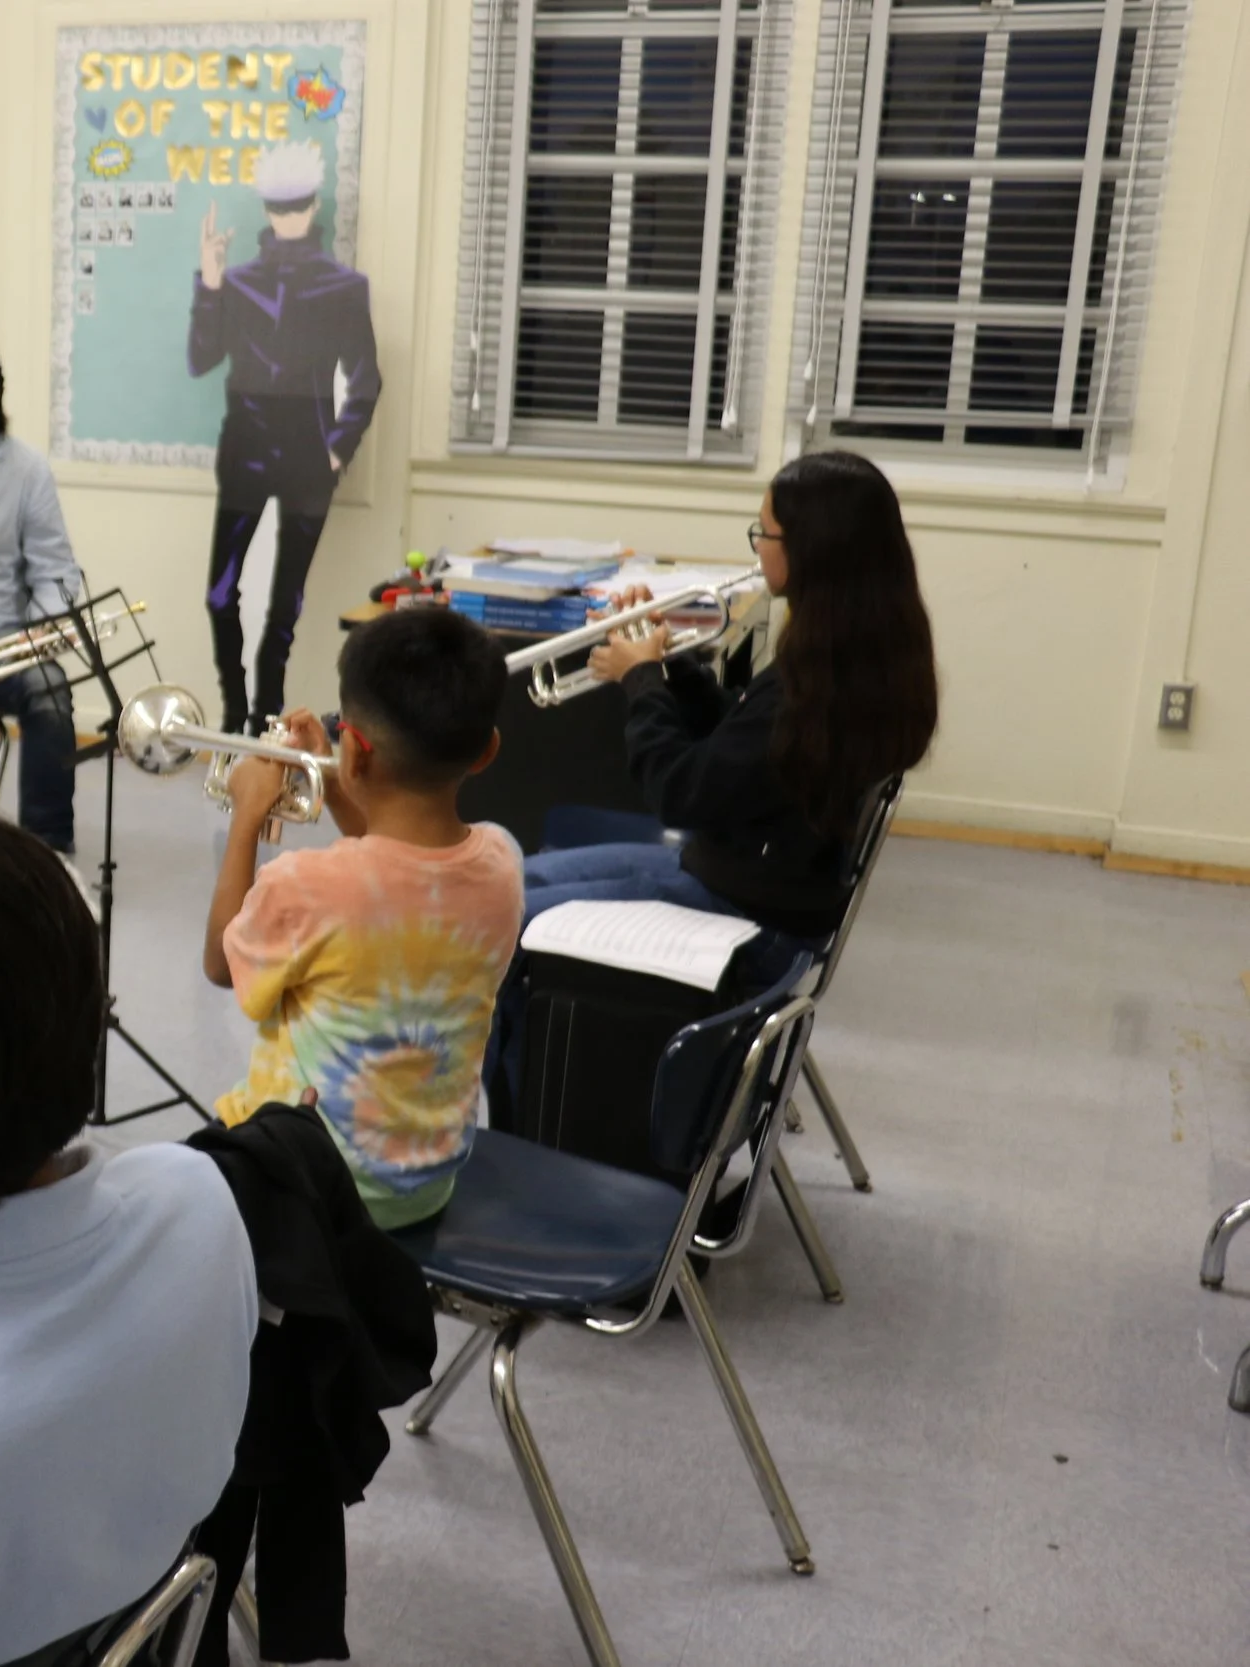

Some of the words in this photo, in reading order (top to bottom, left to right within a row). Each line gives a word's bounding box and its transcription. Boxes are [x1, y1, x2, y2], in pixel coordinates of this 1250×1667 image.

[80, 52, 293, 91] STUDENT
[114, 98, 175, 138] OF
[202, 101, 290, 140] THE
[167, 144, 261, 185] WEE
